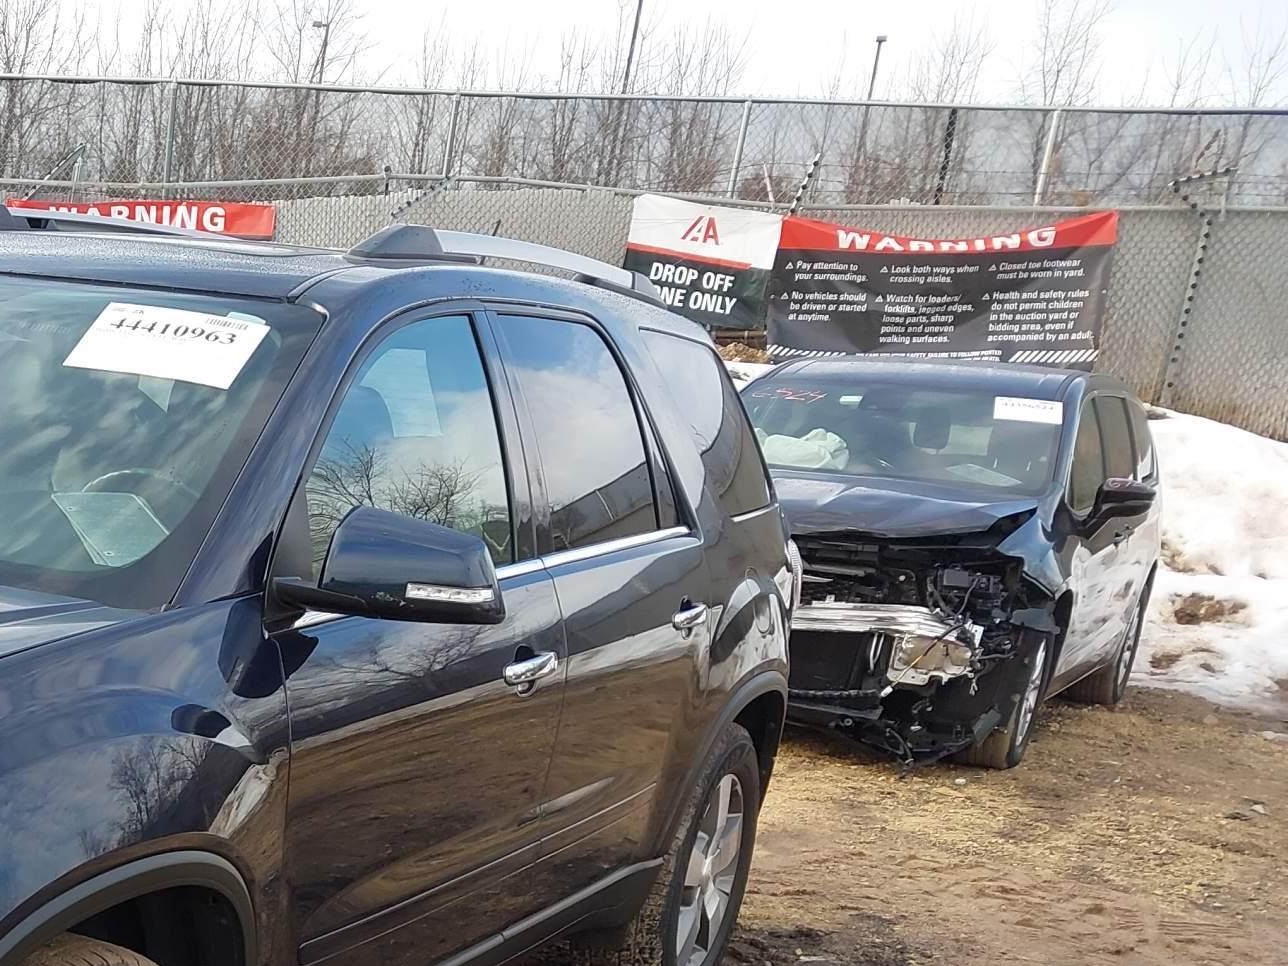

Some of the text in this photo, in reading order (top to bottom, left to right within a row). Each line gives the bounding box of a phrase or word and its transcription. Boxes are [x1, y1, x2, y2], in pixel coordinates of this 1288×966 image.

[49, 205, 227, 231] RNING
[796, 261, 858, 273] Pay attention to
[891, 265, 979, 275] Look both ways when
[999, 259, 1081, 271] Closed toe footwear
[649, 262, 735, 292] DROP OFF
[795, 273, 868, 283] your surroundings.
[889, 274, 952, 284] crossing aisles.
[996, 268, 1085, 280] must be worn in yard.
[792, 292, 867, 302] No vehicles should
[886, 294, 913, 303] Watch
[915, 294, 927, 303] for
[992, 289, 1090, 300] Health and safety rules
[689, 291, 737, 315] ONLY
[790, 302, 800, 310] be
[801, 302, 827, 311] driven
[838, 303, 867, 312] started
[884, 303, 975, 314] forklifts, jagged edges,
[991, 300, 1084, 312] do not permit children
[788, 313, 831, 322] at anytime.
[882, 314, 954, 324] loose parts, sharp
[989, 311, 1080, 321] in the auction yard or
[110, 317, 237, 345] 44410963
[880, 325, 954, 334] points and uneven
[988, 322, 1074, 333] bidding area, even if
[879, 335, 950, 345] walking surfaces.
[987, 332, 1045, 342] accompanied
[1046, 331, 1057, 342] by
